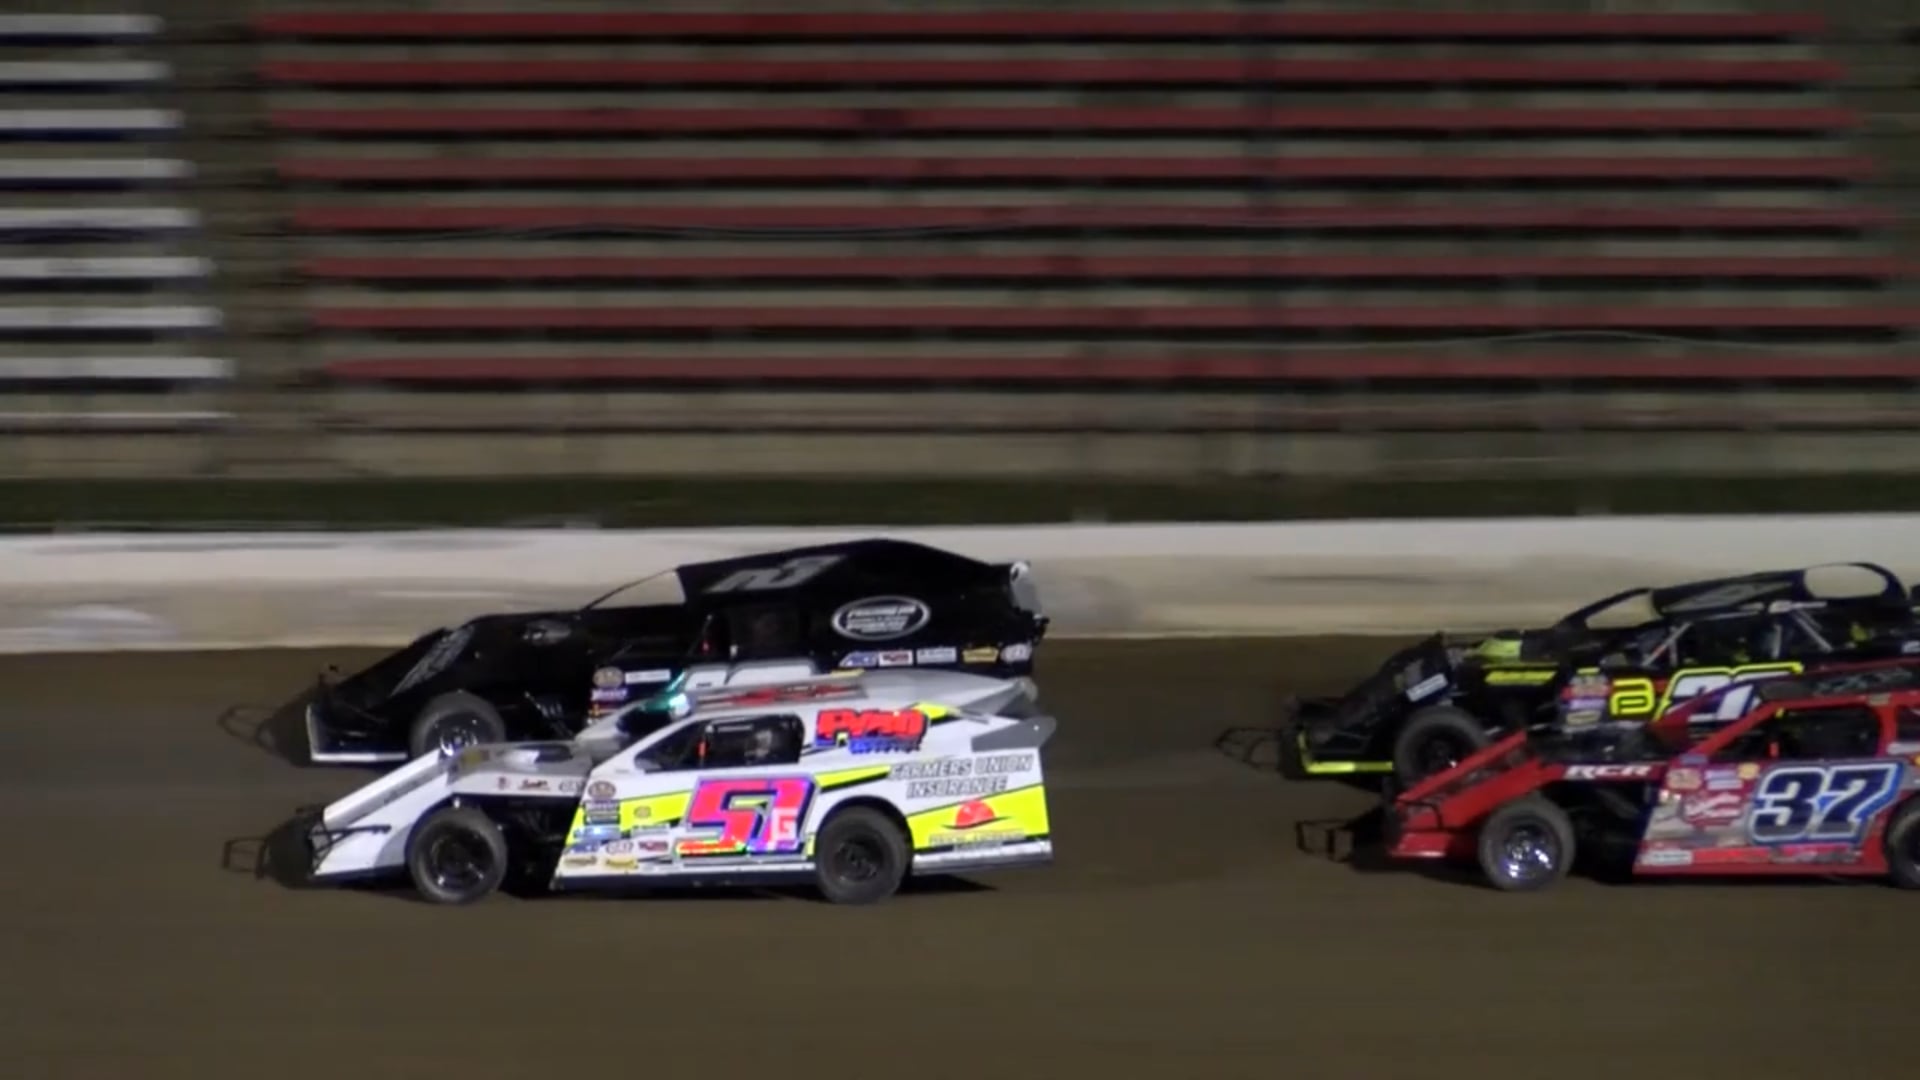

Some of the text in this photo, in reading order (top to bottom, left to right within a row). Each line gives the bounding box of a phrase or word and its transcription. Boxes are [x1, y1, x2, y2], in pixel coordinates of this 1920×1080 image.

[888, 754, 1034, 780] FARMERS UNION
[1563, 764, 1651, 780] RCR
[906, 776, 1008, 799] INSURANCE
[1749, 761, 1903, 845] 37
[676, 776, 816, 858] 51
